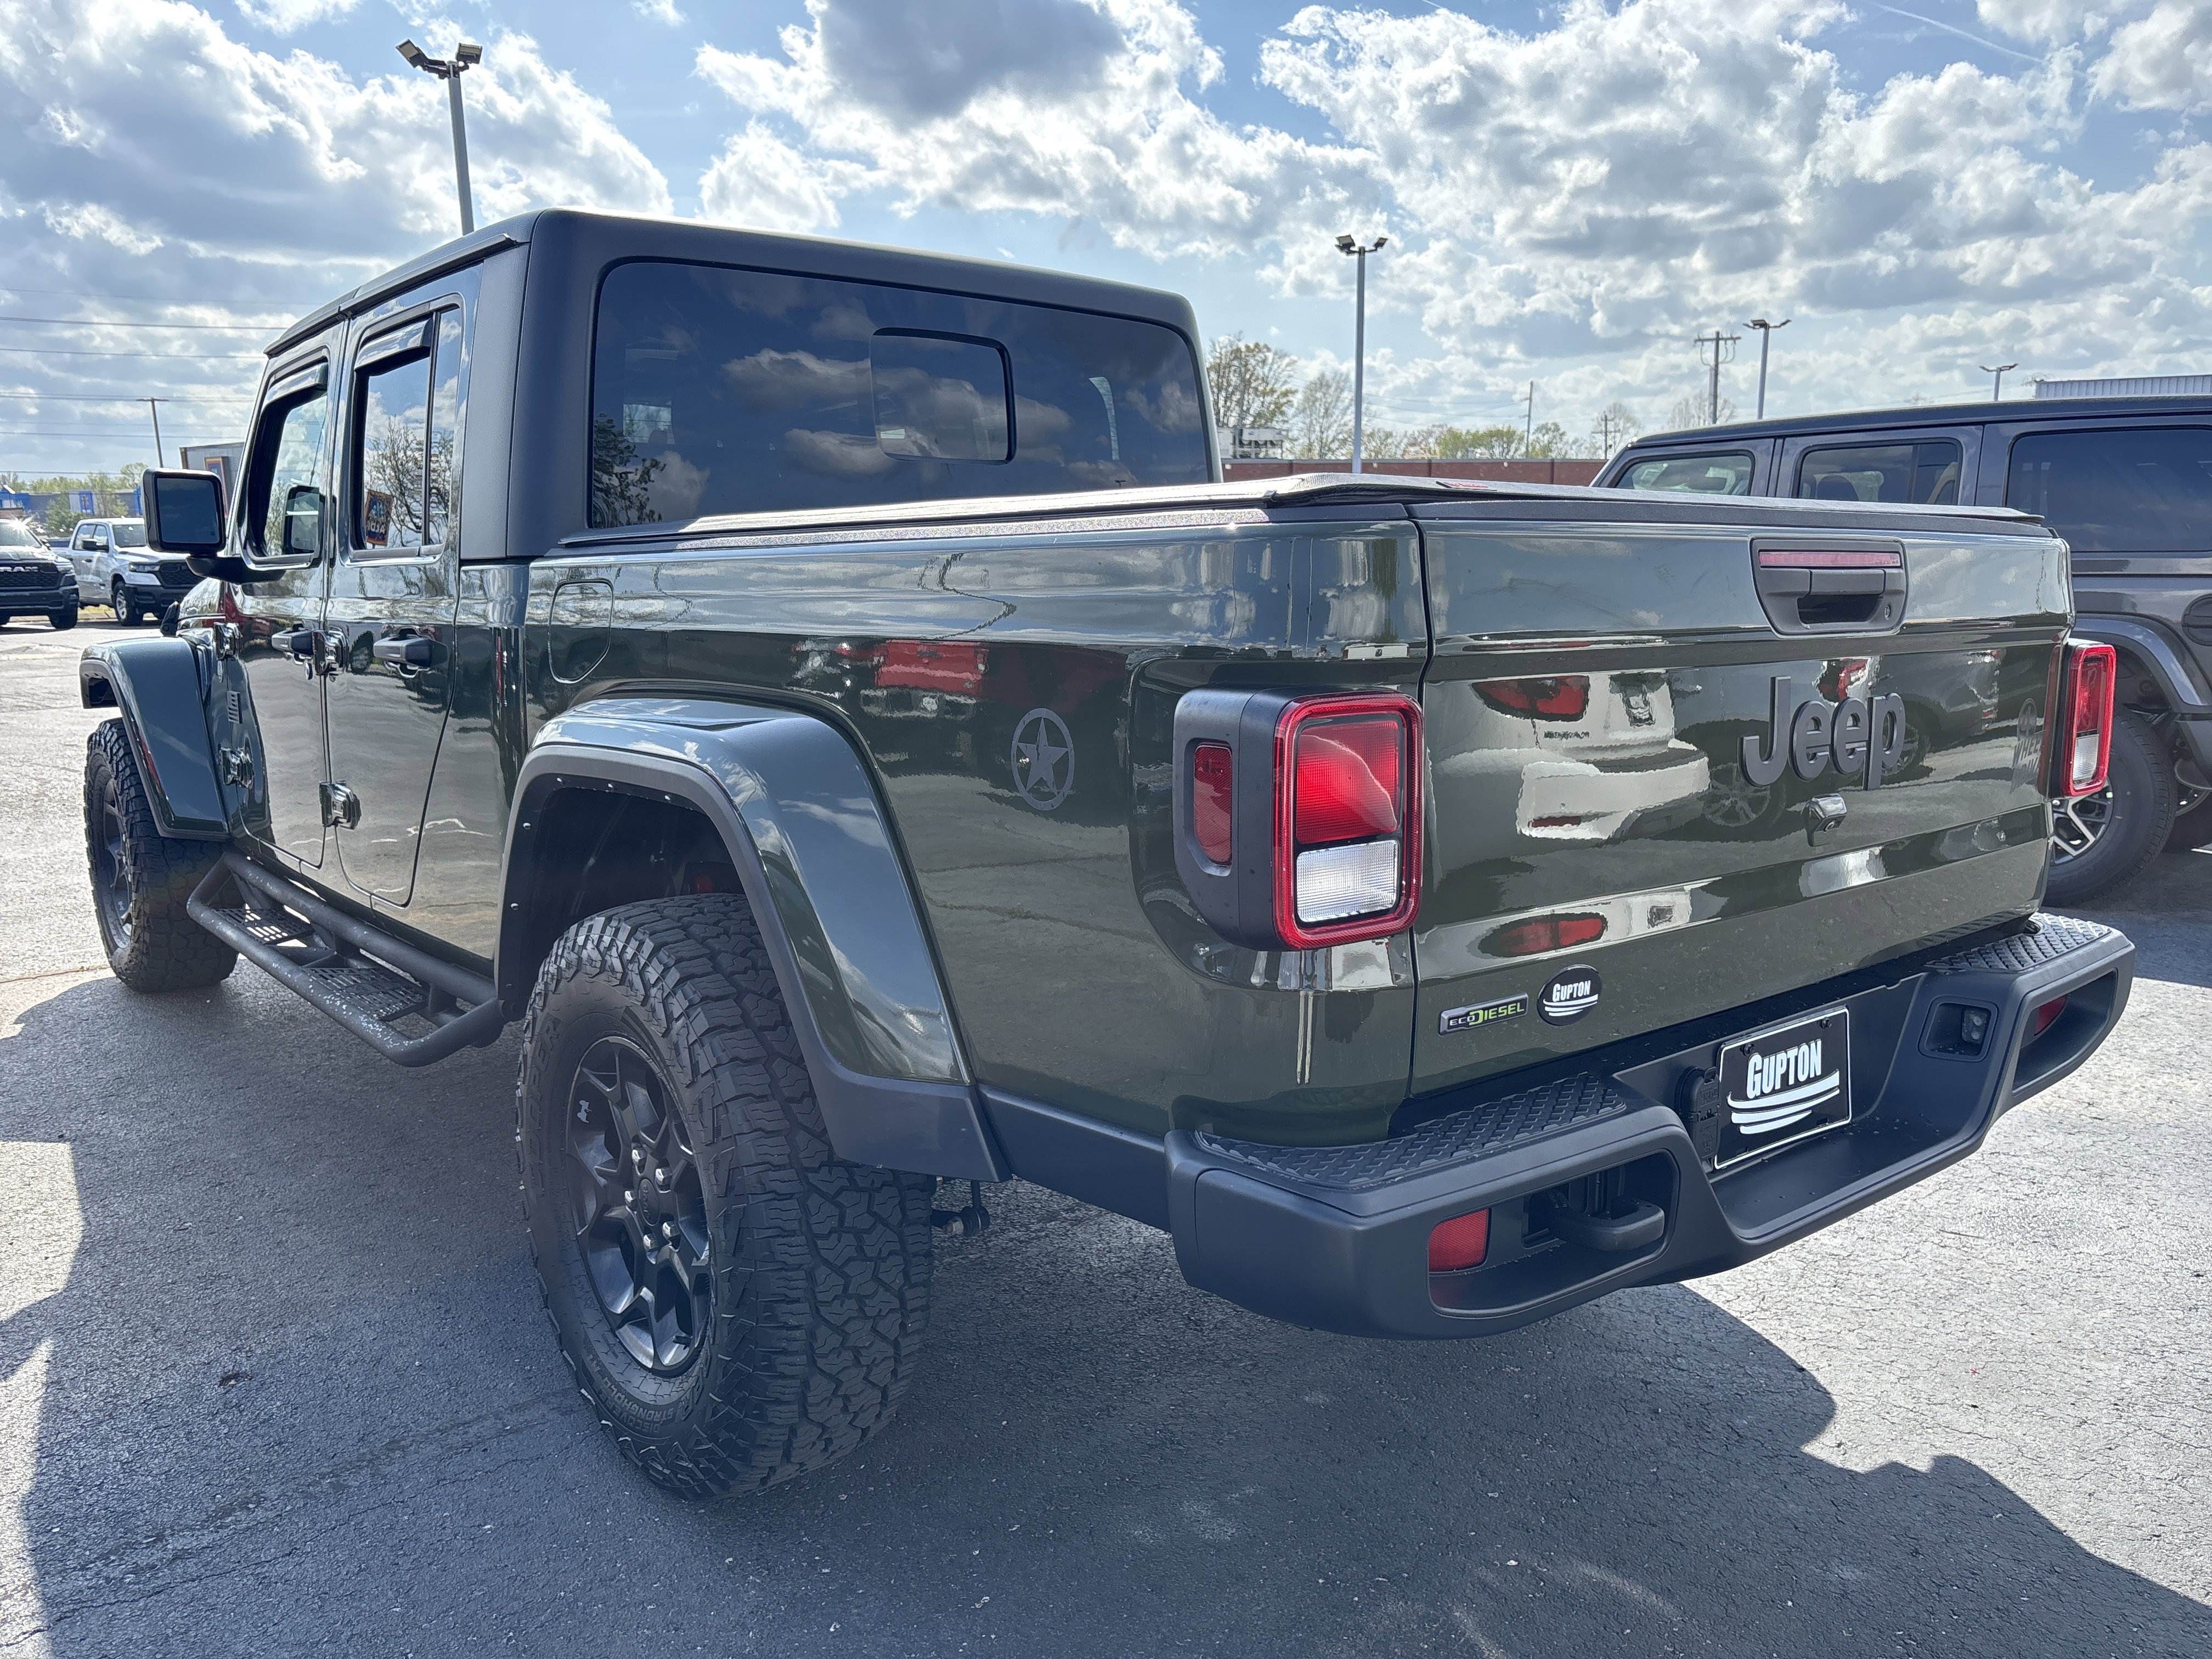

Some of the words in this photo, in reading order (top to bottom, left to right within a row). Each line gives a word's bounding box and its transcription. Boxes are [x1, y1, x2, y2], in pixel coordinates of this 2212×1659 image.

[1737, 675, 1905, 791] Jeep
[1552, 980, 1592, 1002] GUPTON
[1746, 1039, 1822, 1099] GUPTON
[603, 1376, 674, 1422] STRONGHOLD
